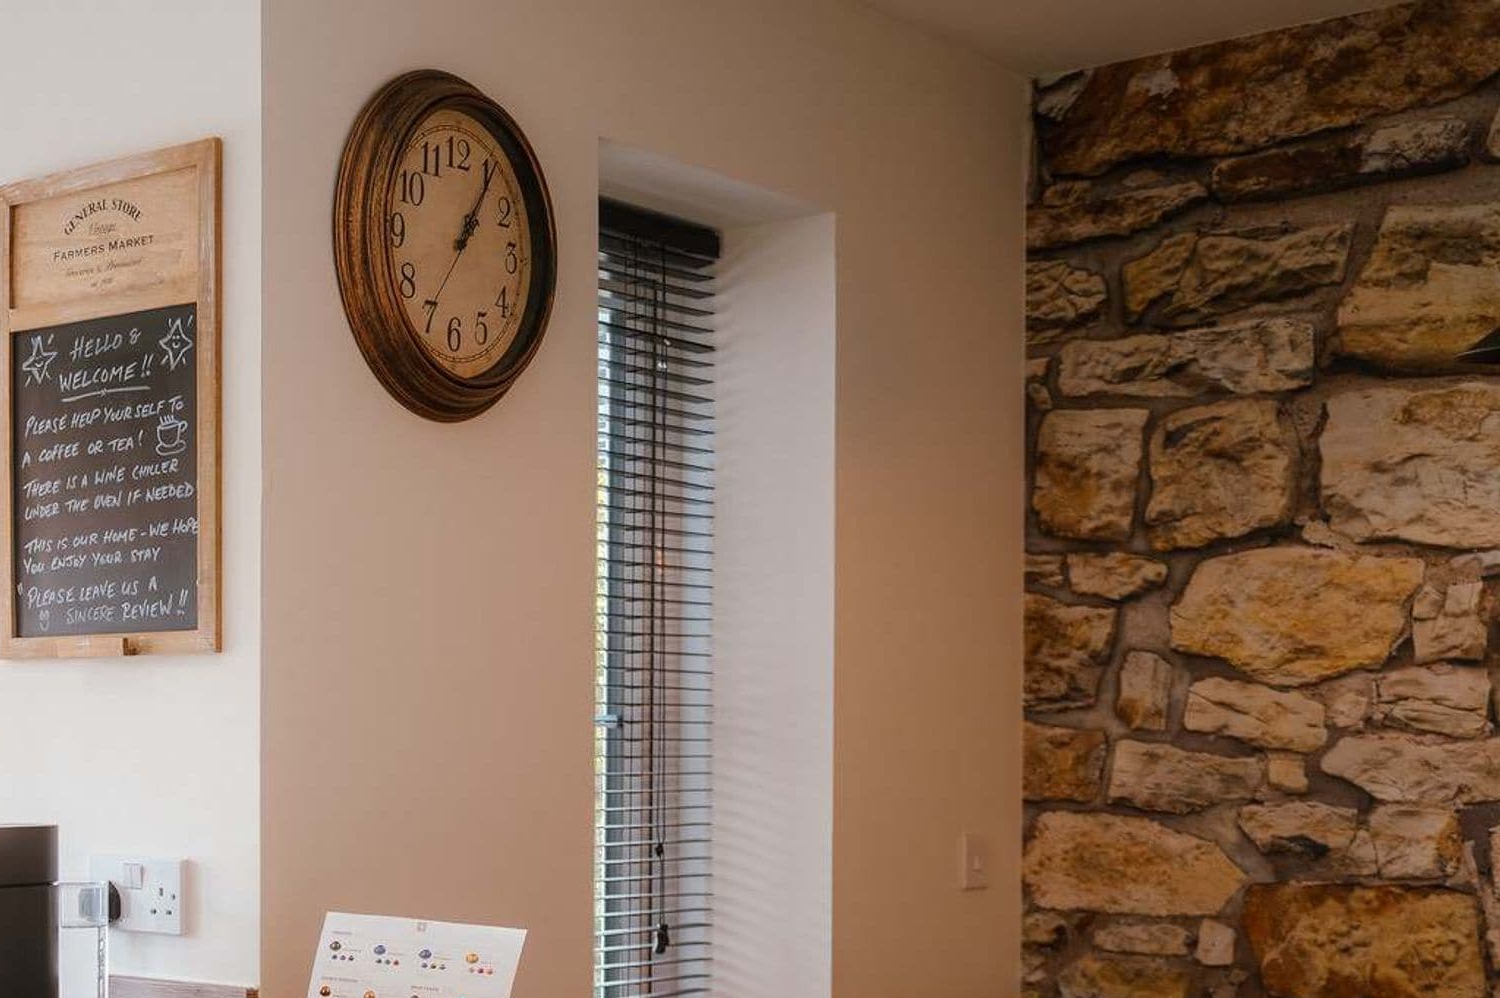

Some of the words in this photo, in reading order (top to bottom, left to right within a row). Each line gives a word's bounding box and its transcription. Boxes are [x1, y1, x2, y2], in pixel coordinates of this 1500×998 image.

[421, 140, 444, 178] 11
[446, 135, 472, 171] 12
[401, 169, 425, 206] 10
[63, 199, 108, 236] GENERAL
[111, 199, 143, 222] STORE
[497, 196, 511, 228] 2
[390, 212, 406, 249] 9
[53, 244, 105, 262] FARMERS
[108, 234, 154, 252] MARKET
[504, 241, 518, 275] 3
[400, 262, 416, 299] 8
[422, 299, 439, 334] 7
[495, 285, 509, 319] 4
[447, 316, 462, 352] 6
[474, 311, 488, 346] 5
[70, 333, 123, 362] HELLO
[24, 414, 67, 440] PLEASE
[70, 408, 101, 430] HELP
[22, 451, 31, 469] A
[38, 442, 80, 463] COFFEE
[87, 440, 104, 455] OR
[23, 478, 62, 499] THERE
[66, 475, 77, 490] IS
[81, 475, 88, 489] A
[94, 465, 126, 485] WINE
[131, 458, 180, 480] CHILLER
[25, 502, 61, 521] UNDER
[64, 498, 88, 513] THE
[93, 490, 122, 510] OVEN
[127, 488, 142, 507] IF
[145, 481, 195, 502] NEEDED
[23, 538, 52, 555] THIS
[56, 538, 70, 551] IS
[72, 532, 100, 549] OUR
[103, 528, 140, 544] HOME
[149, 522, 169, 537] WE
[24, 556, 45, 575] YOU
[51, 554, 88, 572] ENJOY
[92, 550, 123, 568] YOUR
[130, 546, 162, 563] STAY
[27, 585, 76, 610] PLEASE
[80, 580, 116, 600] LEAVE
[121, 580, 140, 595] US
[149, 576, 158, 592] A
[65, 606, 116, 625] SINCERE
